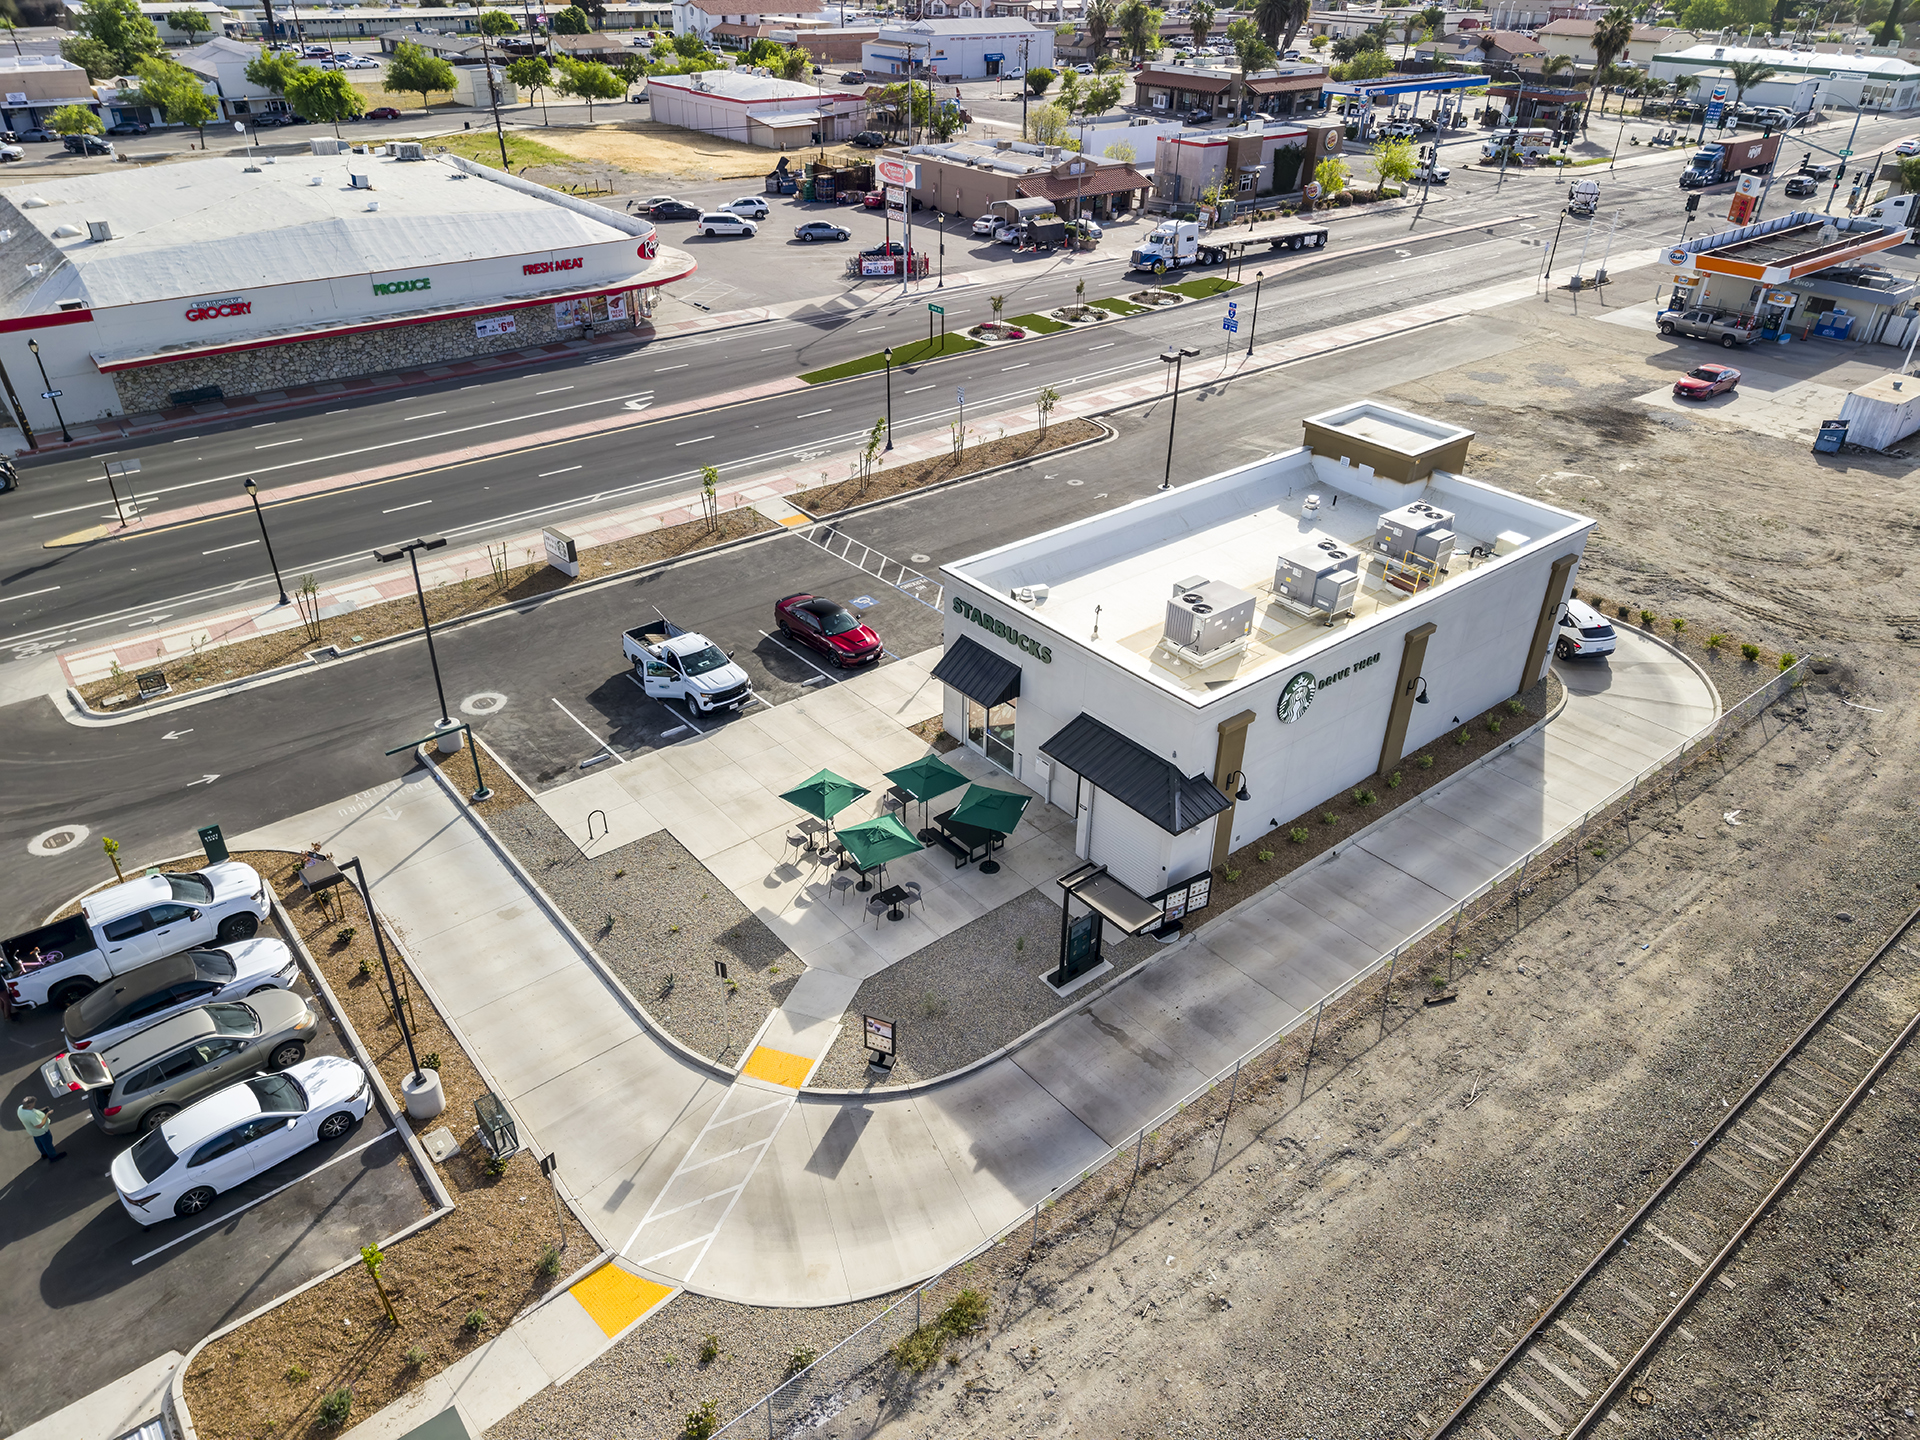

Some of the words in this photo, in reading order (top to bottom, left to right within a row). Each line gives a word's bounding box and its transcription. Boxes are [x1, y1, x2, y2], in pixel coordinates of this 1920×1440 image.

[522, 262, 553, 276] FRESH
[555, 257, 584, 271] MEAT
[1670, 253, 1685, 261] Gulf
[374, 278, 431, 296] PRODUCE
[185, 302, 252, 322] GROCERY
[952, 596, 1053, 665] STARBUCKS
[1318, 667, 1350, 690] DRIVE
[1353, 652, 1380, 673] THRU
[354, 781, 398, 802] ENTRY
[338, 799, 375, 817] THRU
